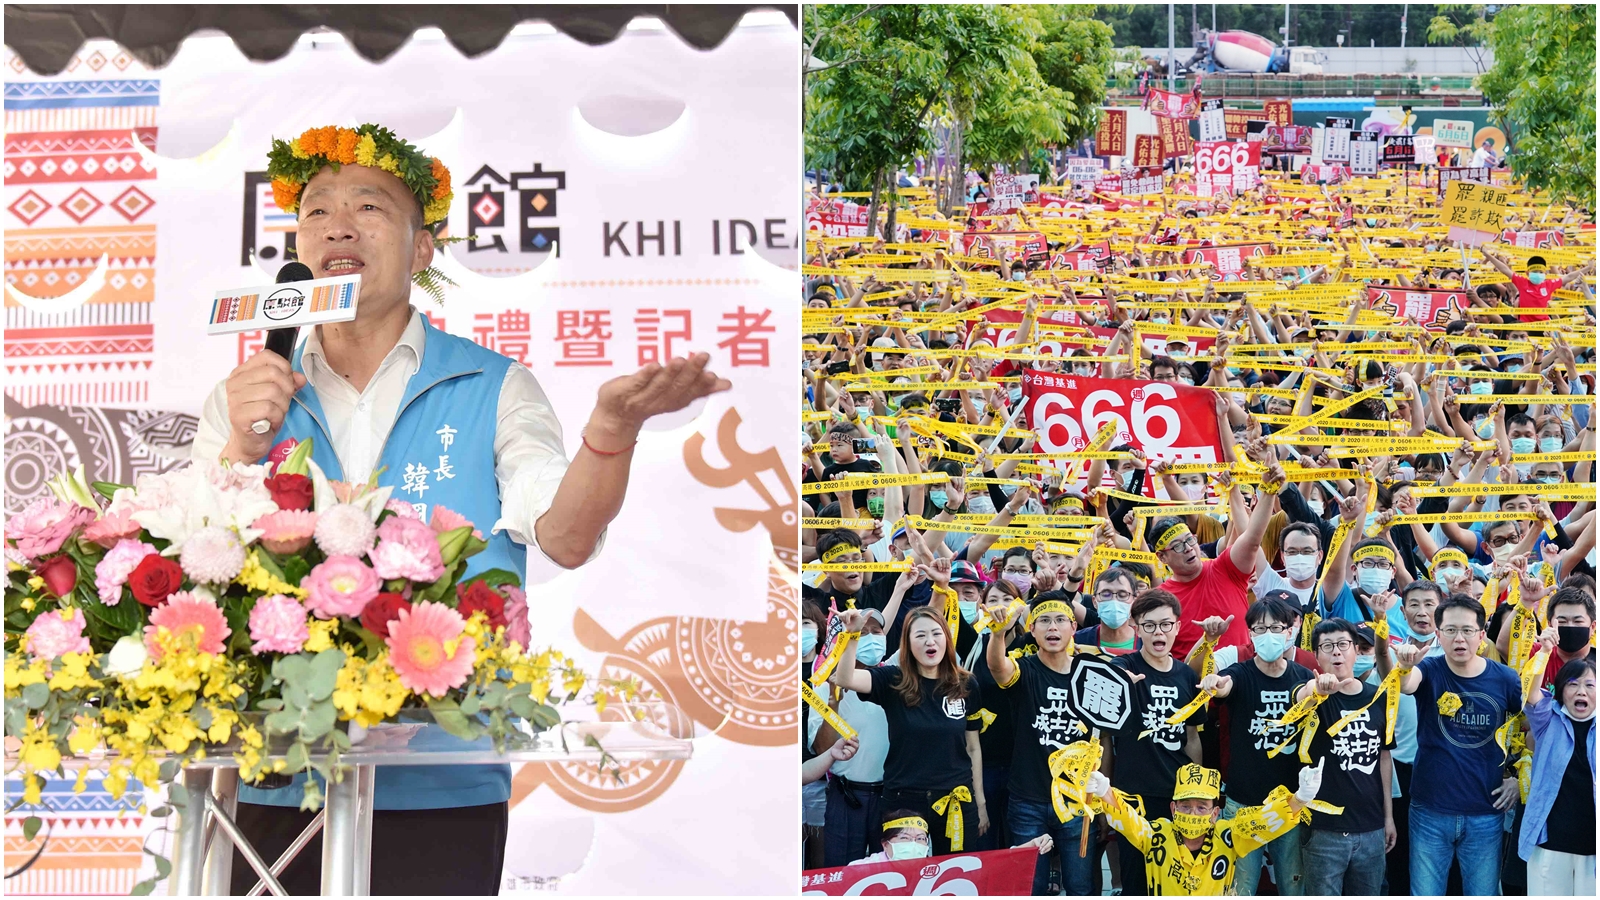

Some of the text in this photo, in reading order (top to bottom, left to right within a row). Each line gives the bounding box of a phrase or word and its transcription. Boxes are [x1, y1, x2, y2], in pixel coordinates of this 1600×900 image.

[1195, 142, 1250, 174] 666
[603, 220, 681, 257] KHI
[712, 218, 798, 255] IDE
[425, 305, 776, 368] 禮暨記者
[1033, 374, 1077, 390] 台灣基進
[1131, 388, 1145, 401] 週
[433, 424, 458, 482] 市長
[823, 482, 838, 490] 2020
[1163, 529, 1176, 541] 2020
[830, 543, 844, 556] 2020
[1360, 547, 1373, 555] 2020
[1034, 603, 1047, 615] 2020
[1082, 668, 1124, 722] 罷
[921, 865, 938, 878] 週
